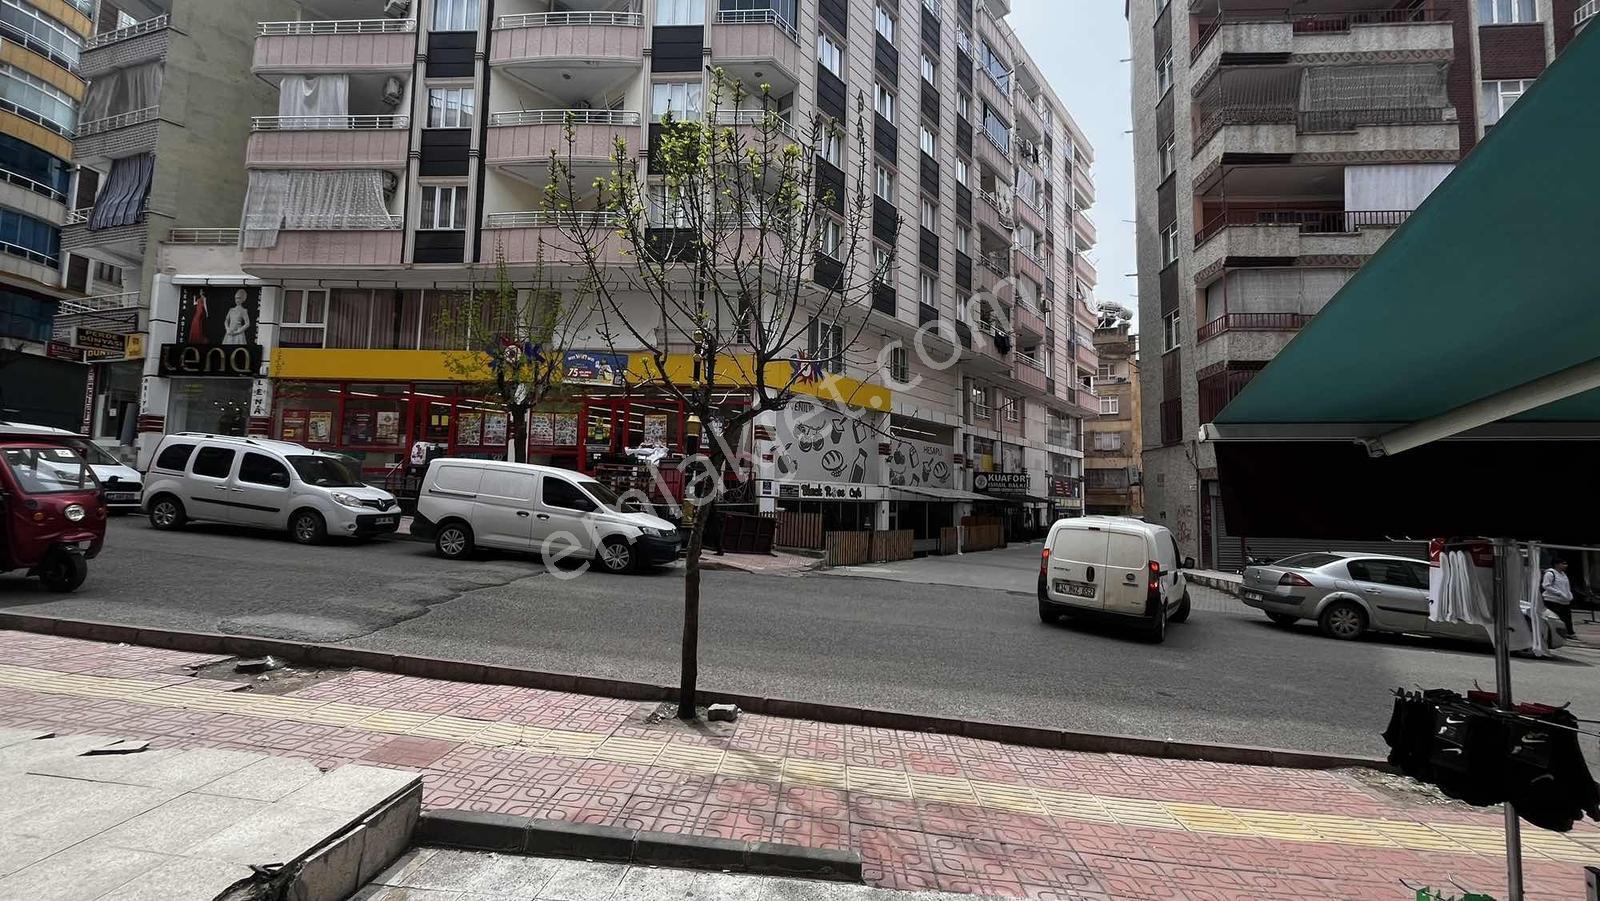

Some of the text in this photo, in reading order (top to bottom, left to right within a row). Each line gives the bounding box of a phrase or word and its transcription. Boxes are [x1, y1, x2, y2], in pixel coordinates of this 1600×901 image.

[567, 367, 579, 377] 75
[254, 380, 263, 414] LENA
[801, 483, 823, 497] Black
